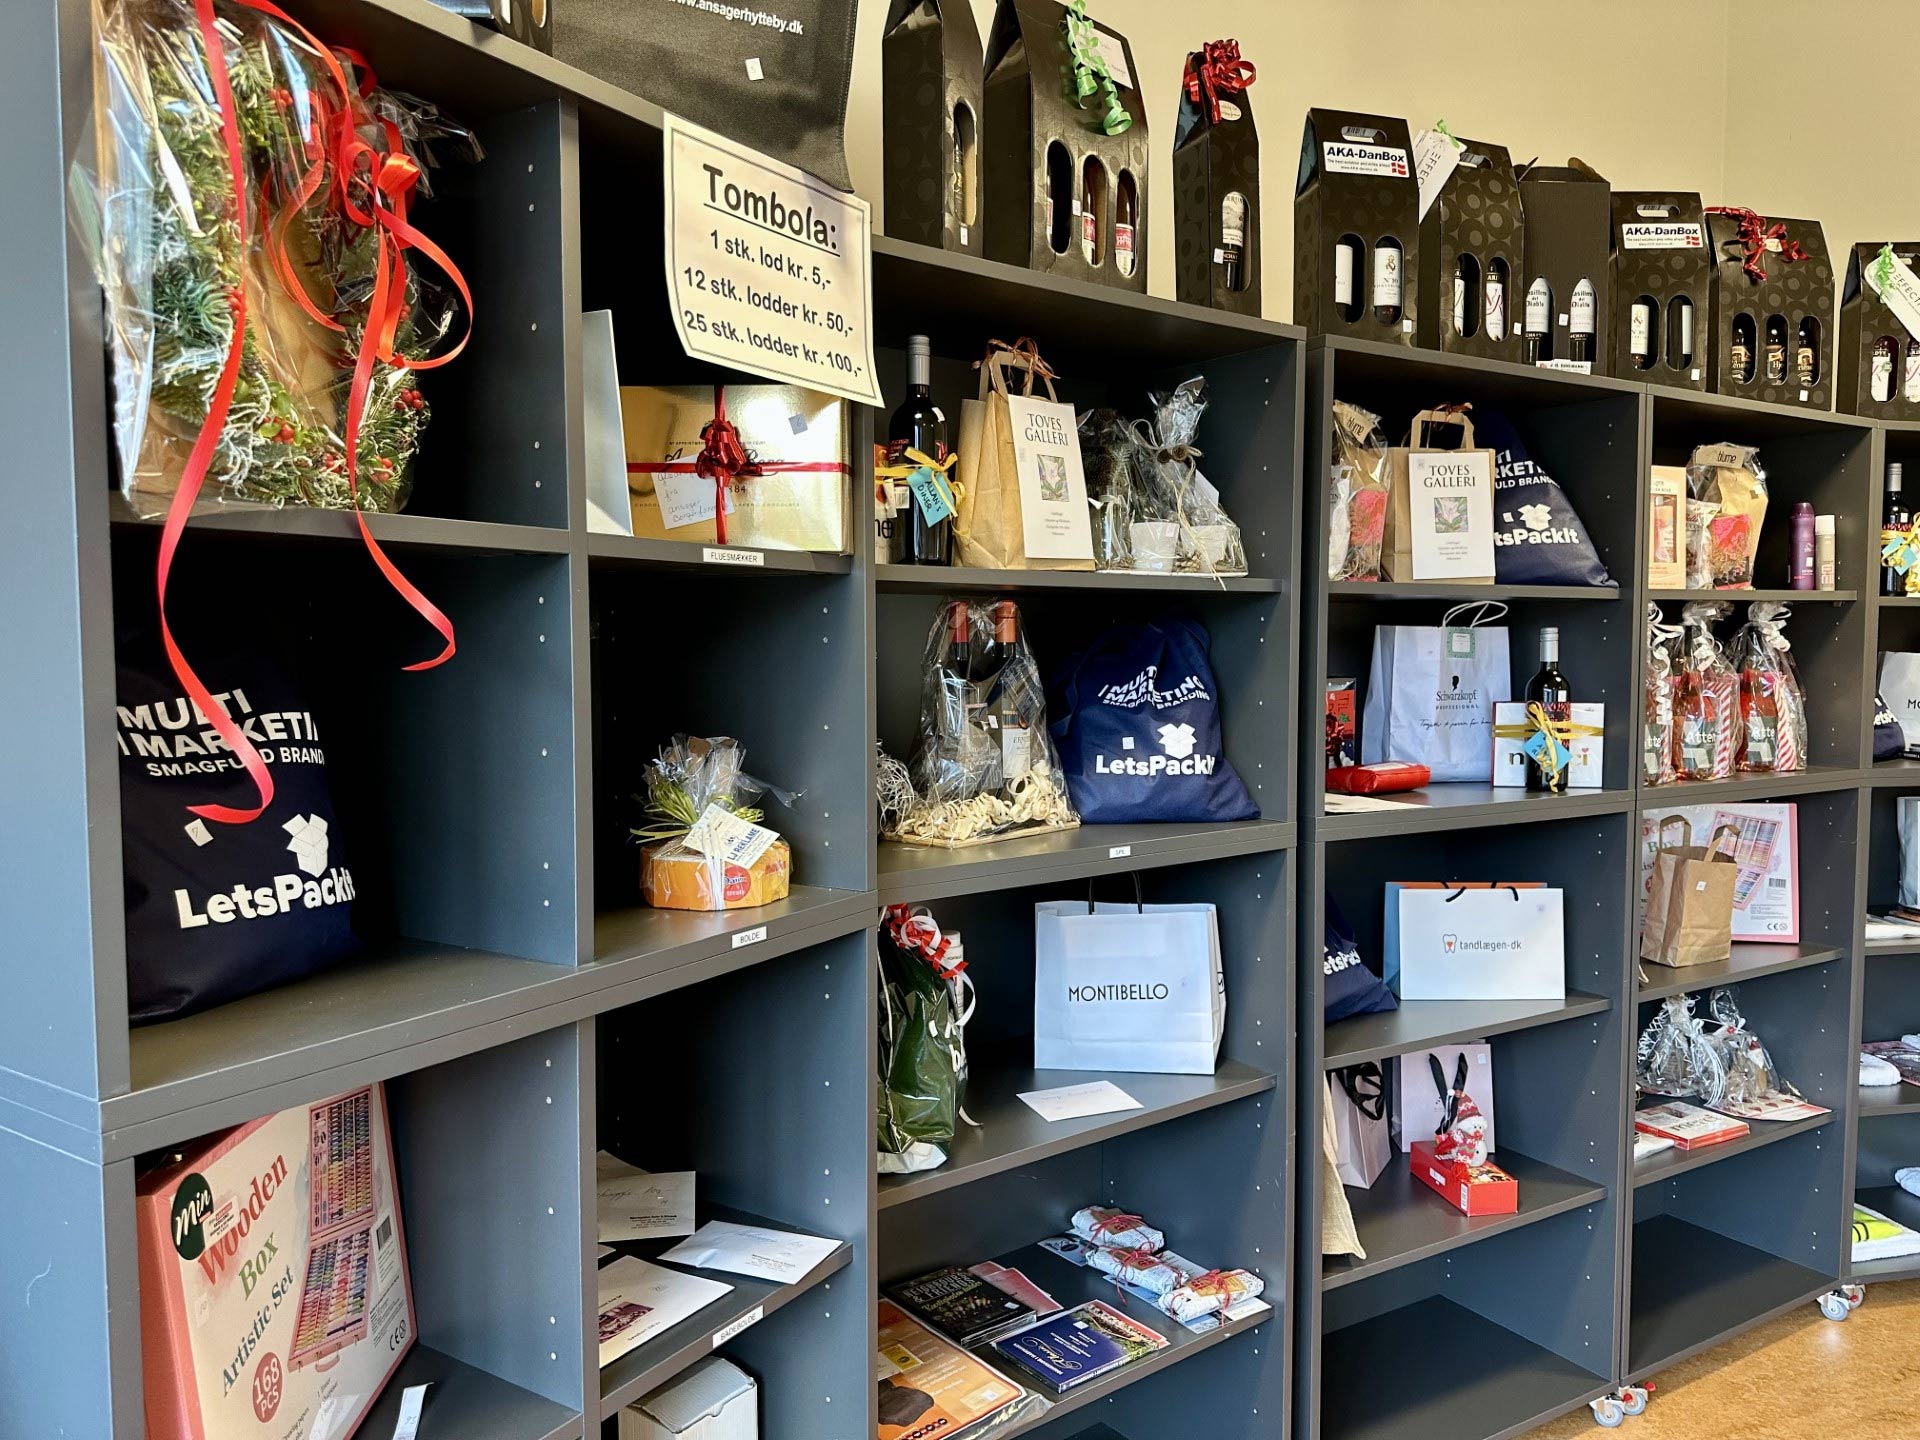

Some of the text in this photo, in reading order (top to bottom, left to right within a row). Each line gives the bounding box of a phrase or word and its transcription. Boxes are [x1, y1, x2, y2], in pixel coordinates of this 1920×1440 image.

[1327, 147, 1405, 162] AKA-DanBox
[1417, 150, 1441, 188] EFFEC
[703, 163, 837, 250] Tombola:
[1626, 226, 1699, 236] AKA-DanBox
[710, 229, 832, 290] 1 stk. lod kr. 5,-
[684, 266, 853, 338] 12 stk. lodder kr. 50,-
[684, 309, 862, 377] 25 stk. lodder kr. 100,-
[1027, 413, 1062, 430] TOVES
[1024, 428, 1069, 447] GALLERI
[1423, 476, 1476, 488] GALLERI
[1430, 465, 1470, 476] TOVES
[1494, 528, 1580, 546] tsPackIt
[1436, 689, 1477, 703] Schwarzkopf
[146, 749, 275, 777] SMAGFUD
[740, 931, 760, 944] BOLDE
[1068, 983, 1169, 1003] MONTIBELLO
[198, 1154, 288, 1286] Wooden
[238, 1231, 279, 1301] Box
[221, 1264, 295, 1399] Artistic Set
[254, 1356, 281, 1403] 168
[260, 1385, 280, 1419] PCS
